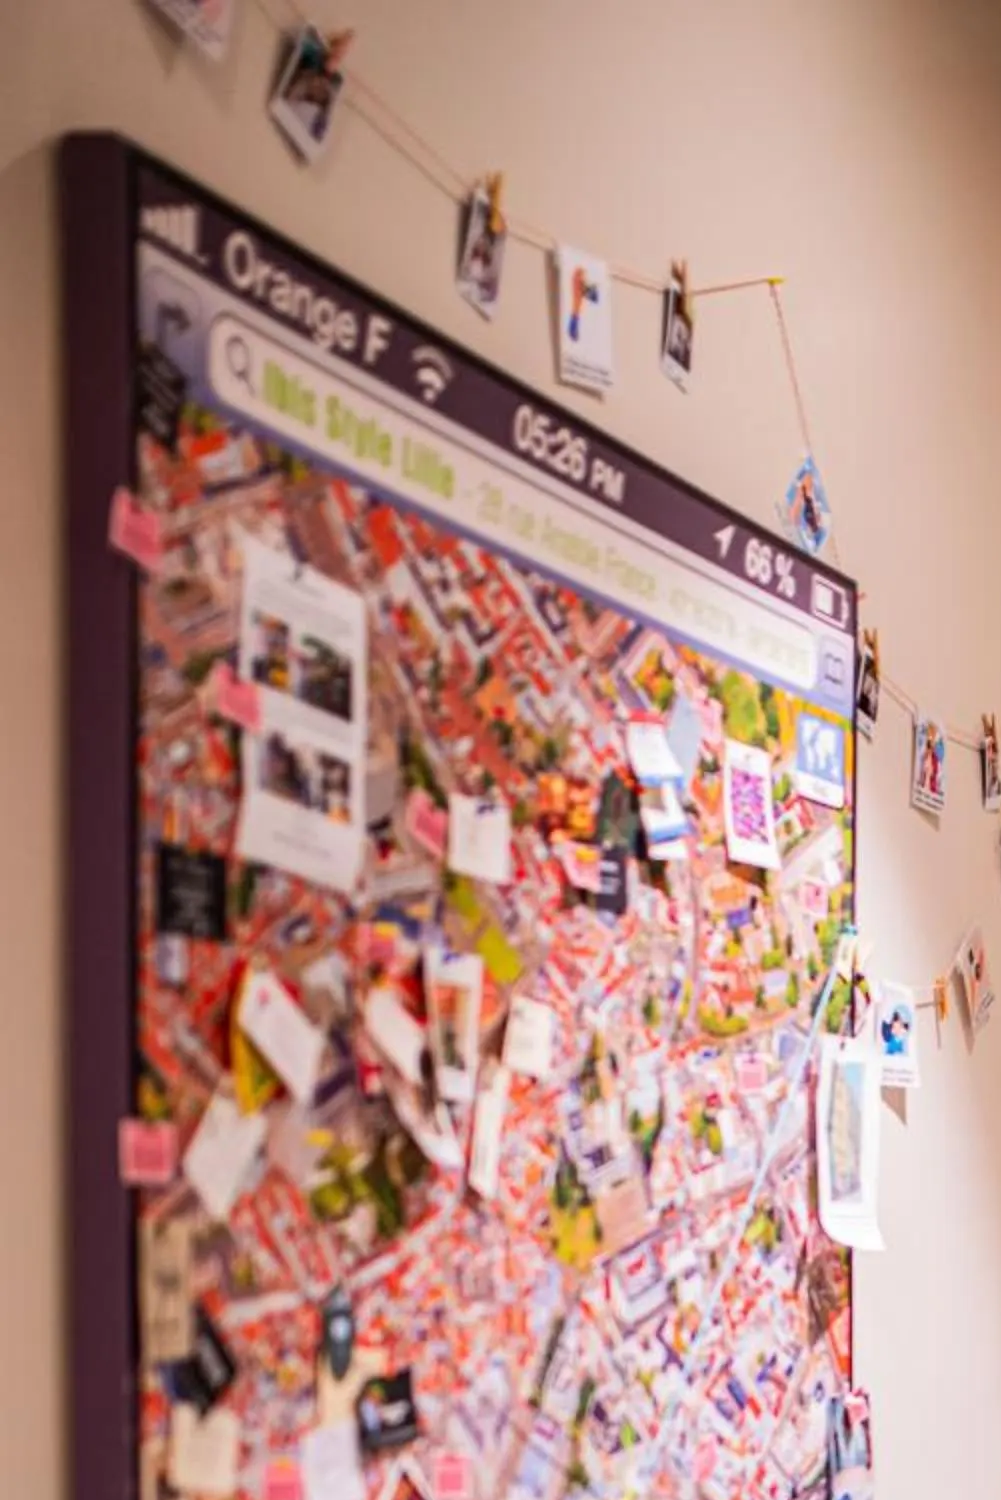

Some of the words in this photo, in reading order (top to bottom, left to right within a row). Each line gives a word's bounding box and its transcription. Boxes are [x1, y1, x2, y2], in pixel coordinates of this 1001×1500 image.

[223, 230, 357, 351] Orange
[363, 313, 393, 366] F
[514, 404, 588, 481] 05:26
[588, 457, 625, 504] PM
